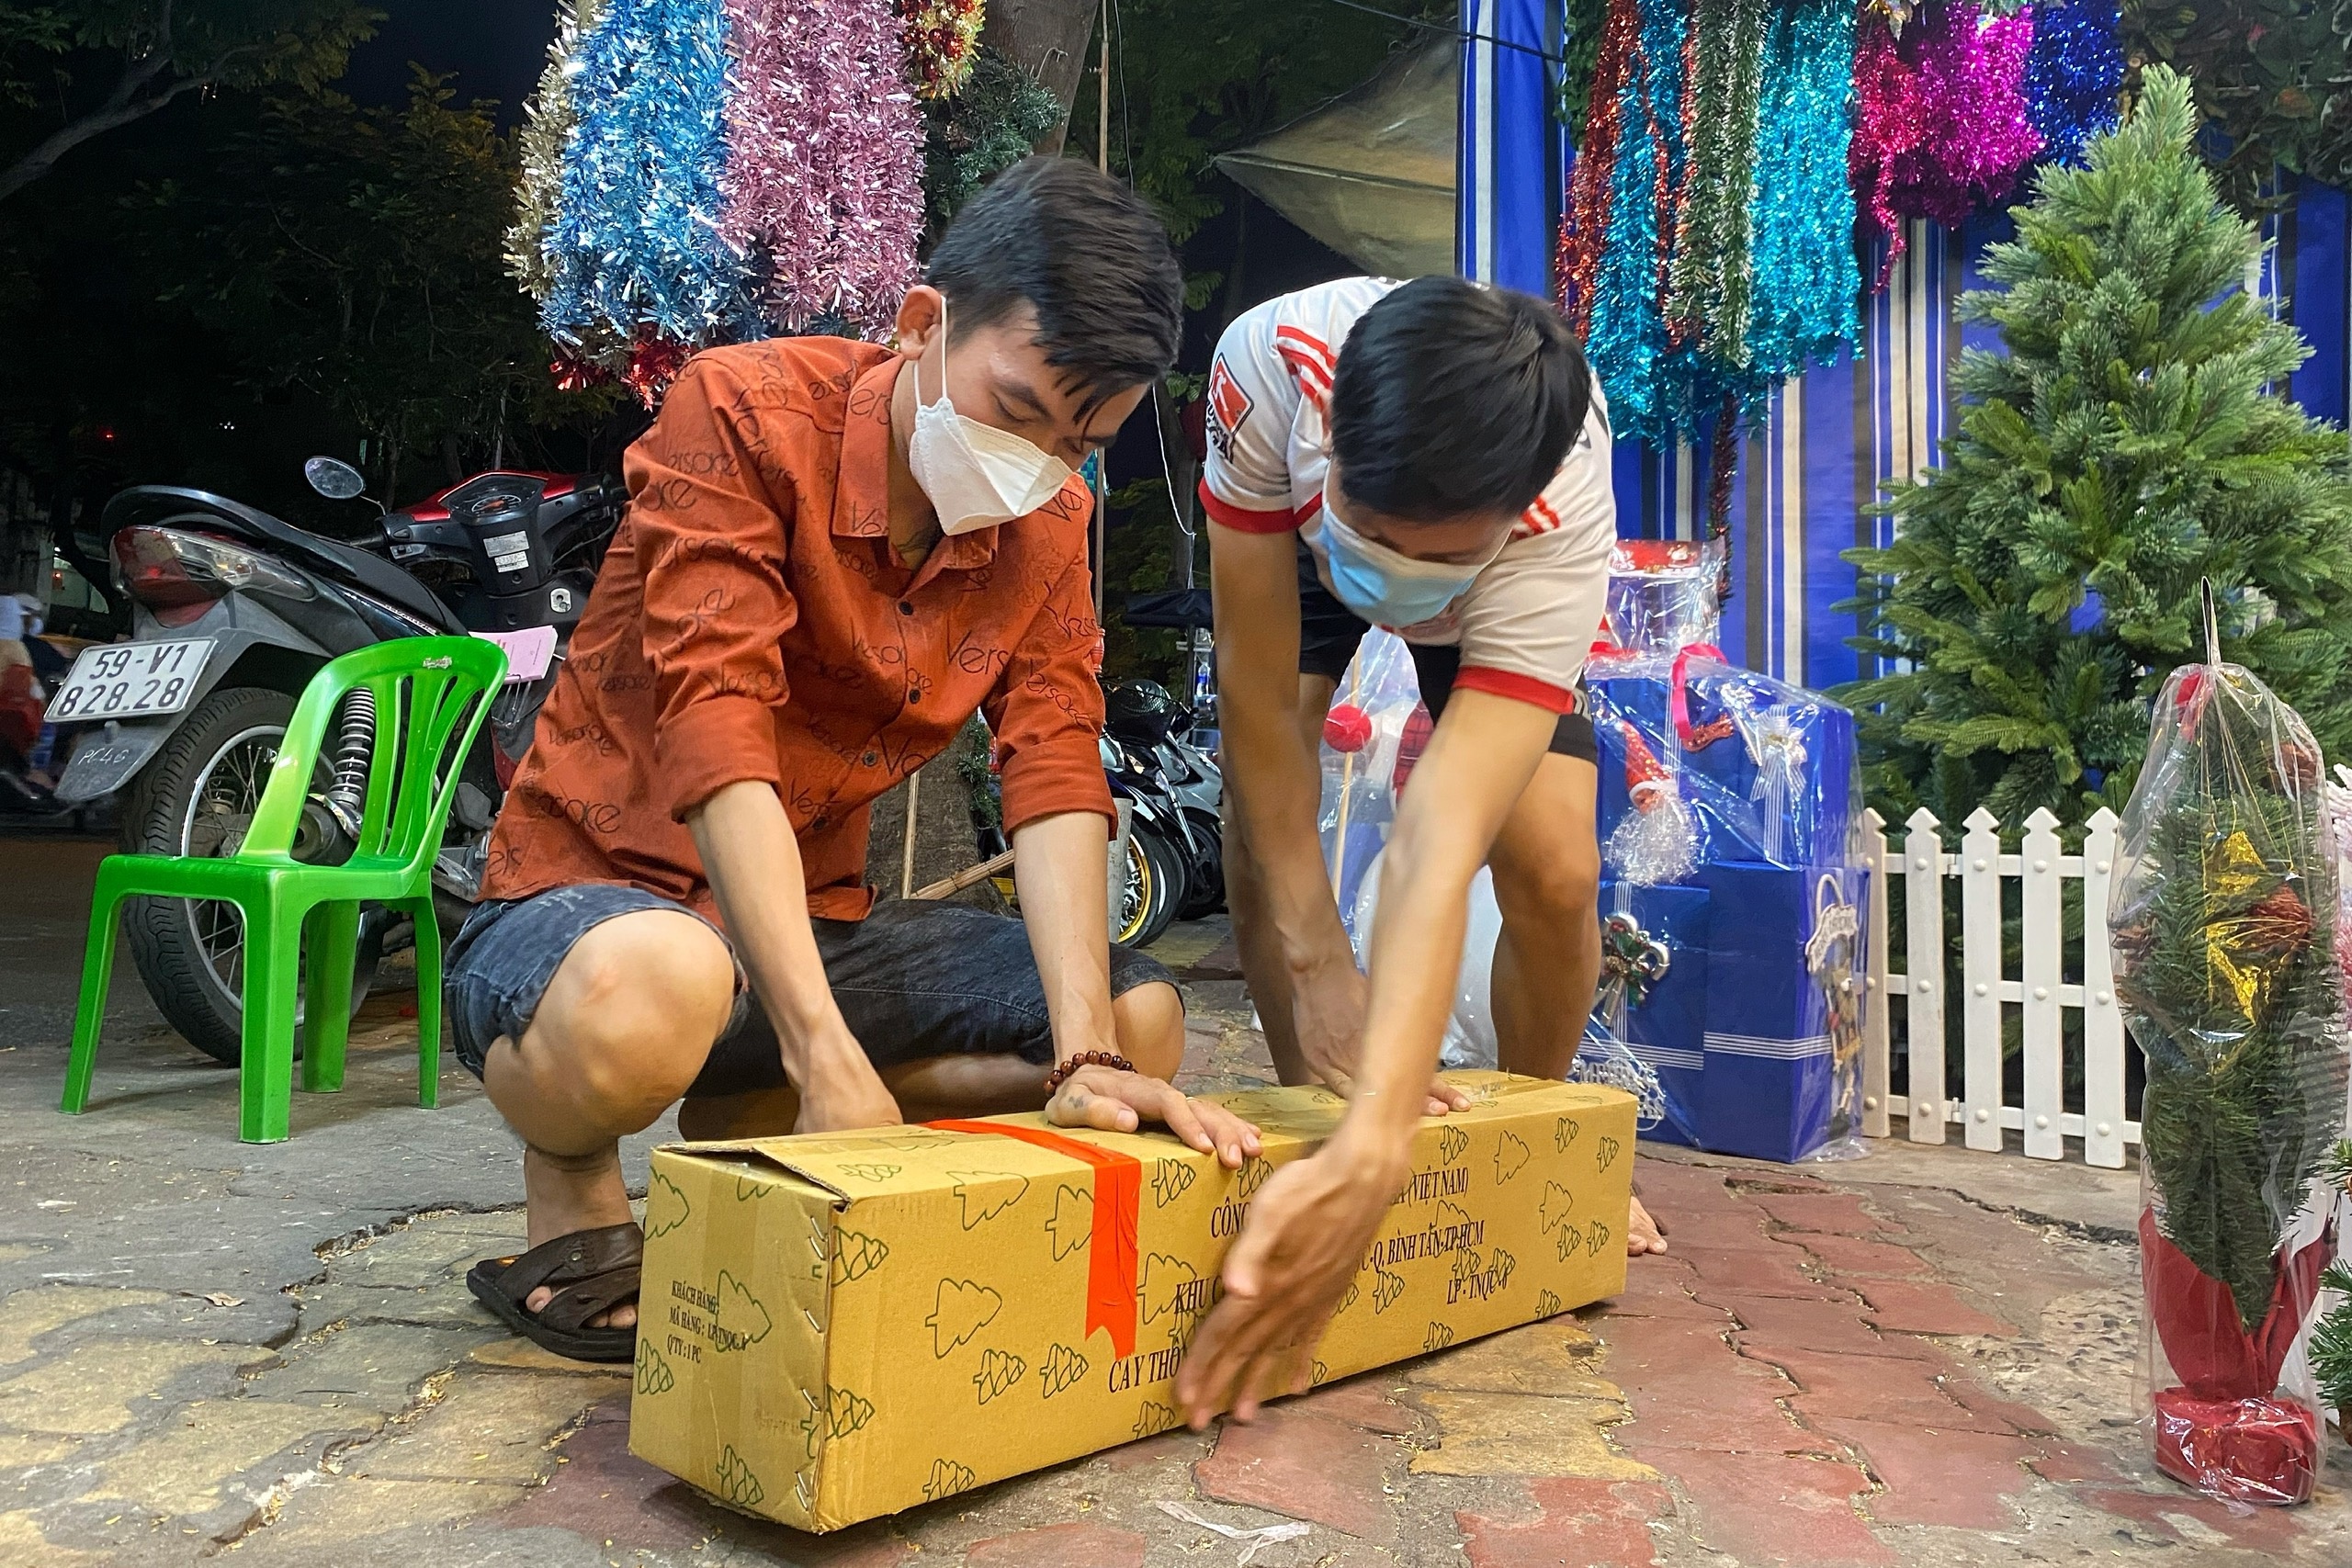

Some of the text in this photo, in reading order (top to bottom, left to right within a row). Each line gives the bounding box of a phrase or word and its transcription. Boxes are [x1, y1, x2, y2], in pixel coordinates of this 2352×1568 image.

[89, 644, 189, 680] 59-V1
[57, 677, 185, 716] 828.28
[1408, 1165, 1440, 1207] (VIỆT
[1441, 1167, 1469, 1198] NAM)
[1387, 1226, 1417, 1265] BÌNH
[672, 1280, 696, 1304] KHÁCH
[1174, 1278, 1209, 1314] KHU
[1148, 1337, 1182, 1383] THÔ
